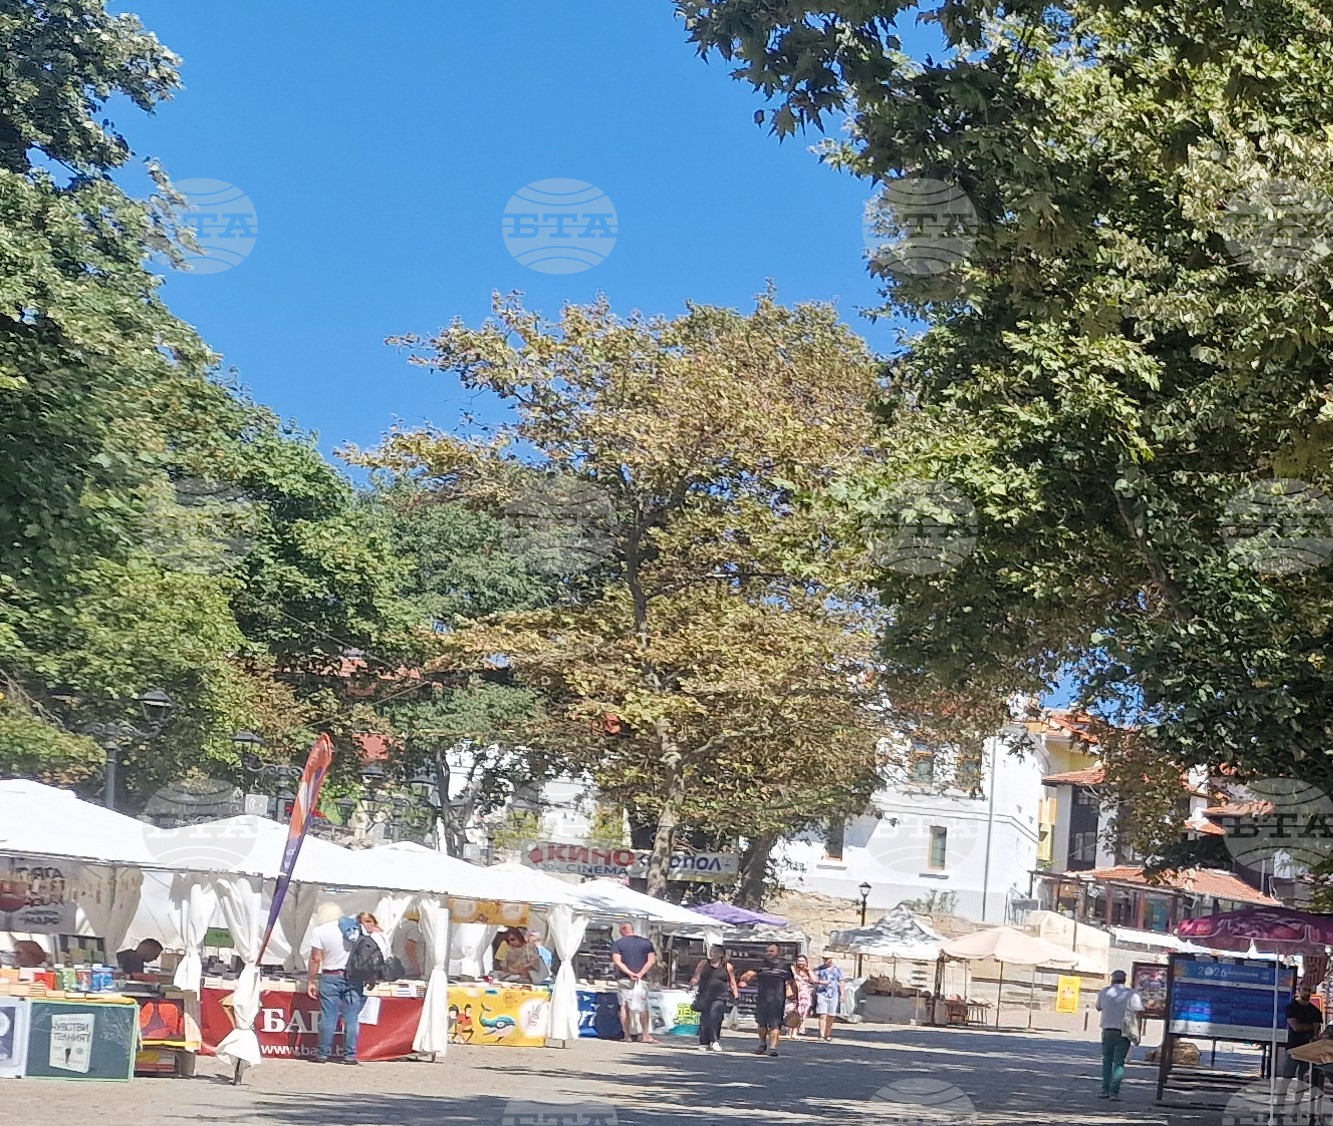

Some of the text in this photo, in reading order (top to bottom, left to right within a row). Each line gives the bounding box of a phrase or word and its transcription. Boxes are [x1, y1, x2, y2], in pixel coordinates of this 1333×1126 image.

[547, 843, 722, 872] КИНО ОПОЛ
[566, 863, 629, 876] CINEMA
